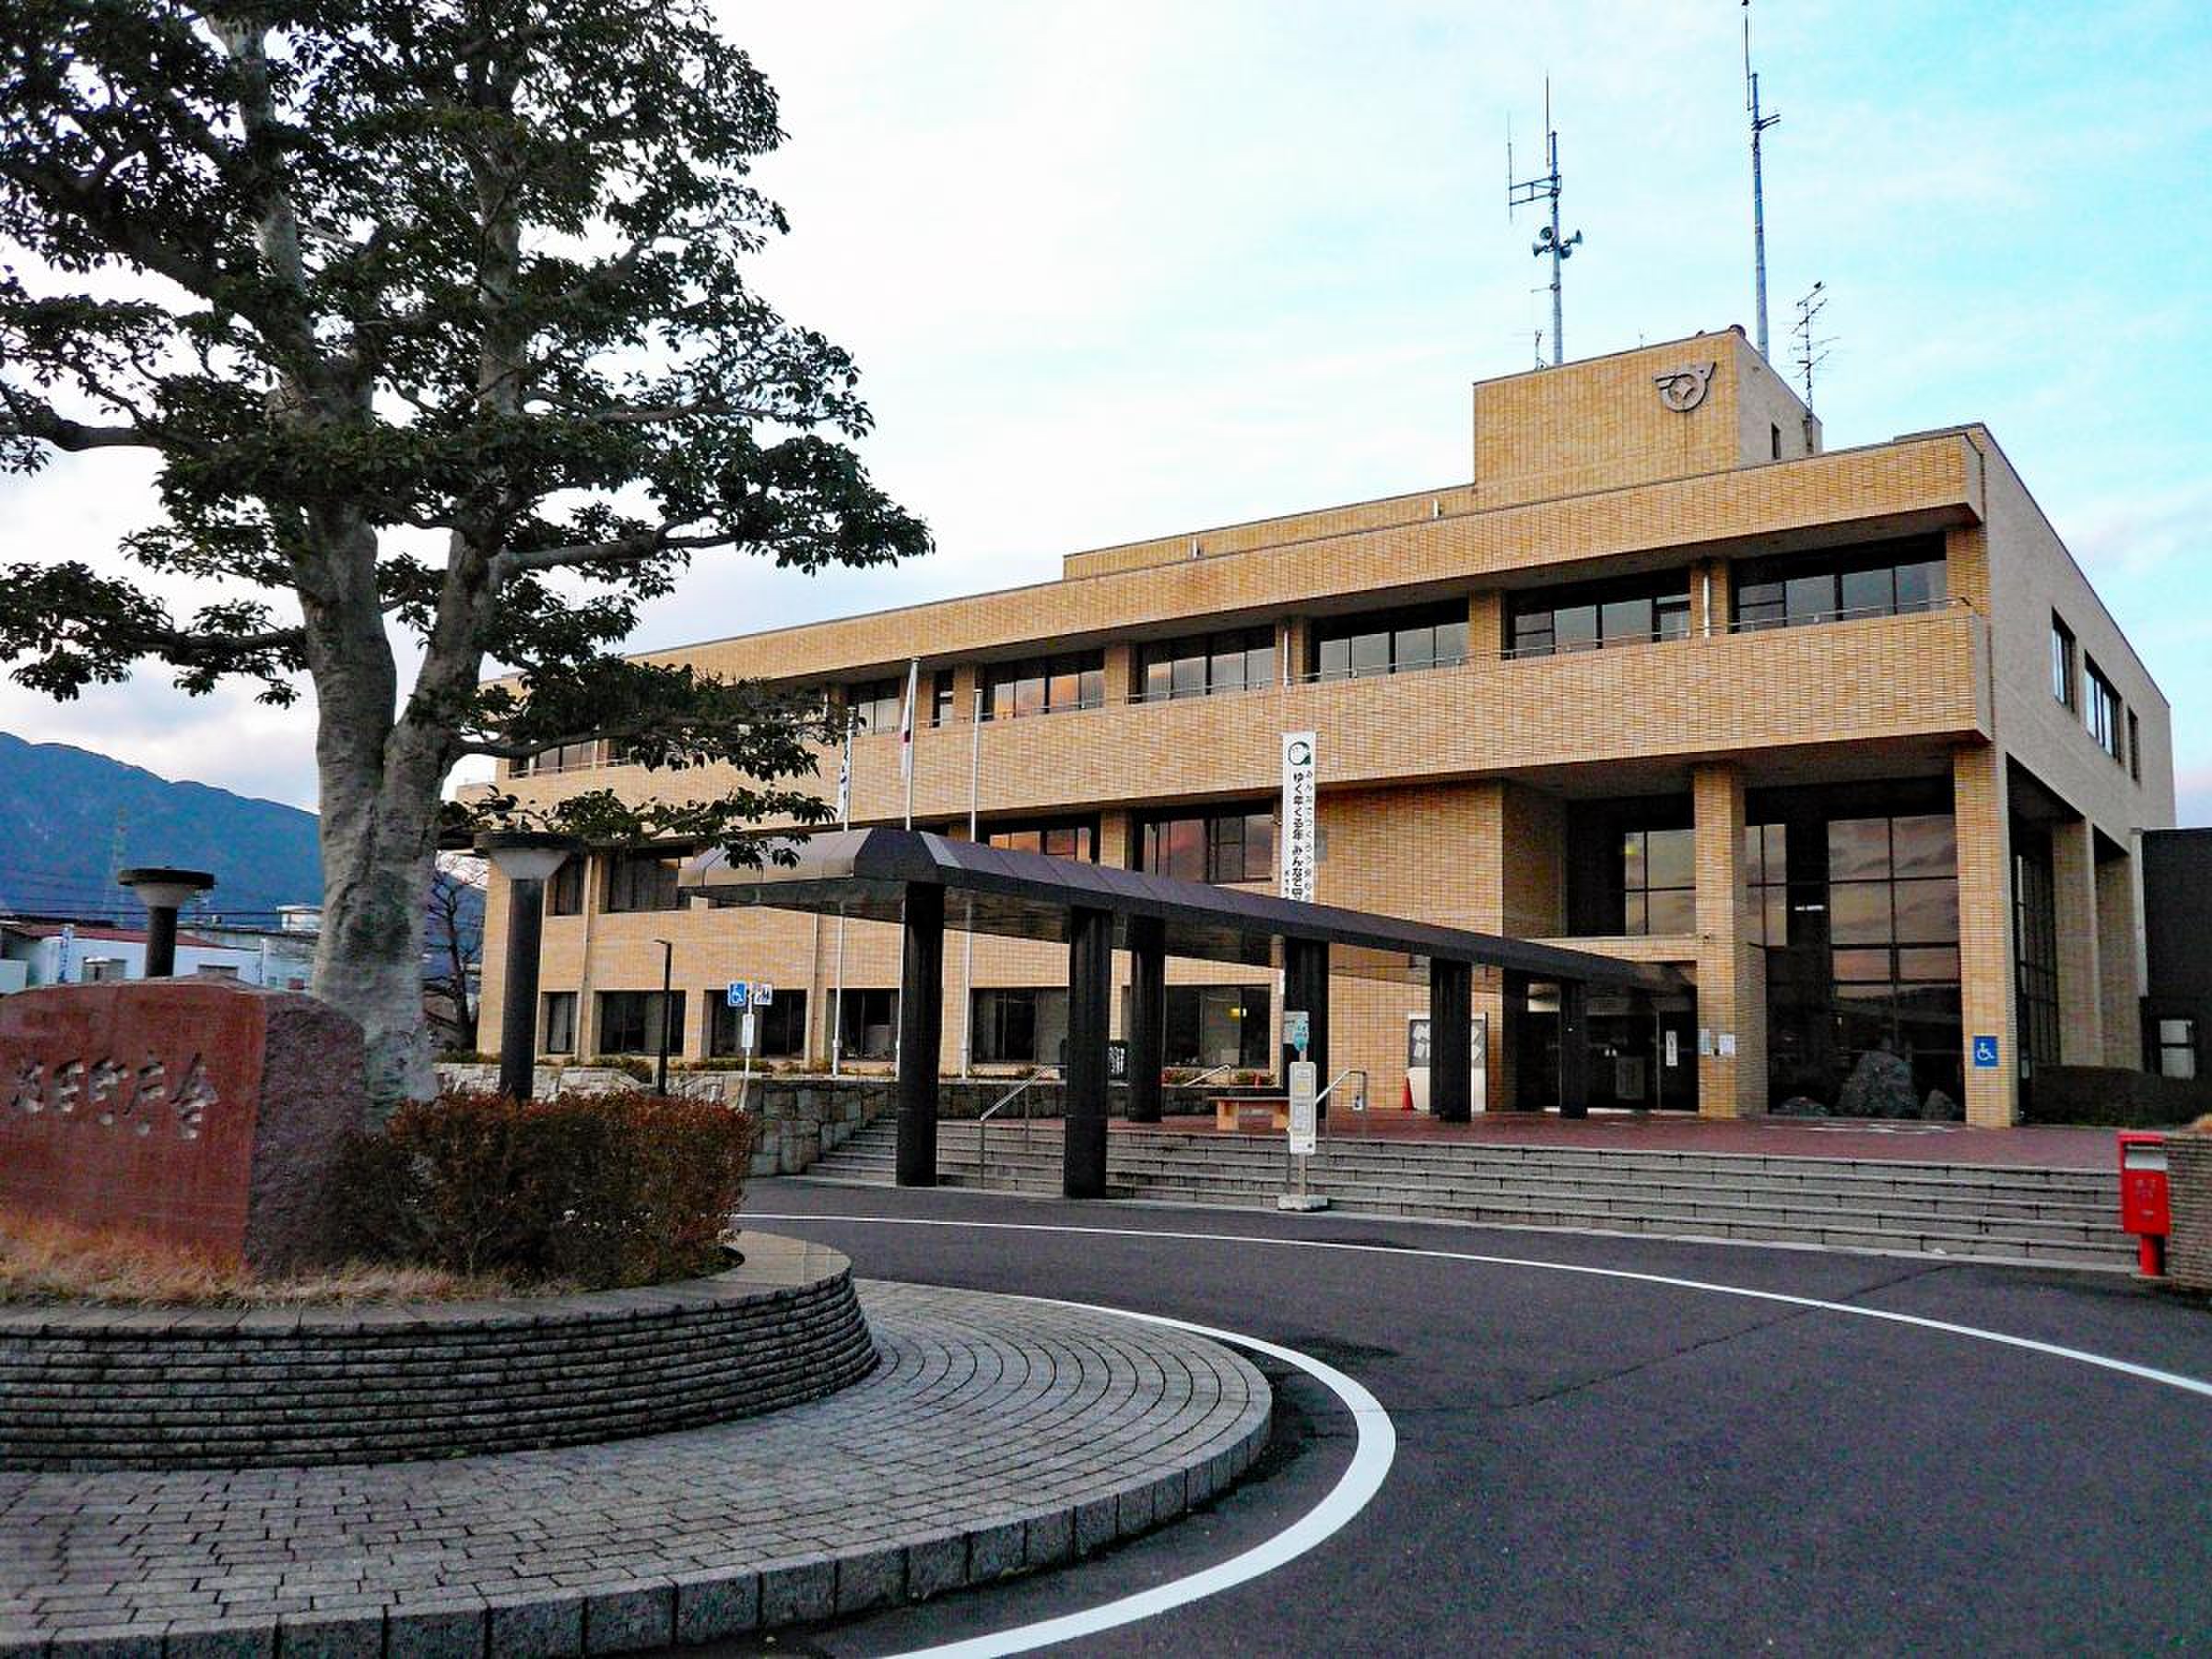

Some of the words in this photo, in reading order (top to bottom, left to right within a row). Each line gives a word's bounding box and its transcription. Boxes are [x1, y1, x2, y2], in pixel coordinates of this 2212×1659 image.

[1292, 771, 1304, 841] ゆく年くる年
